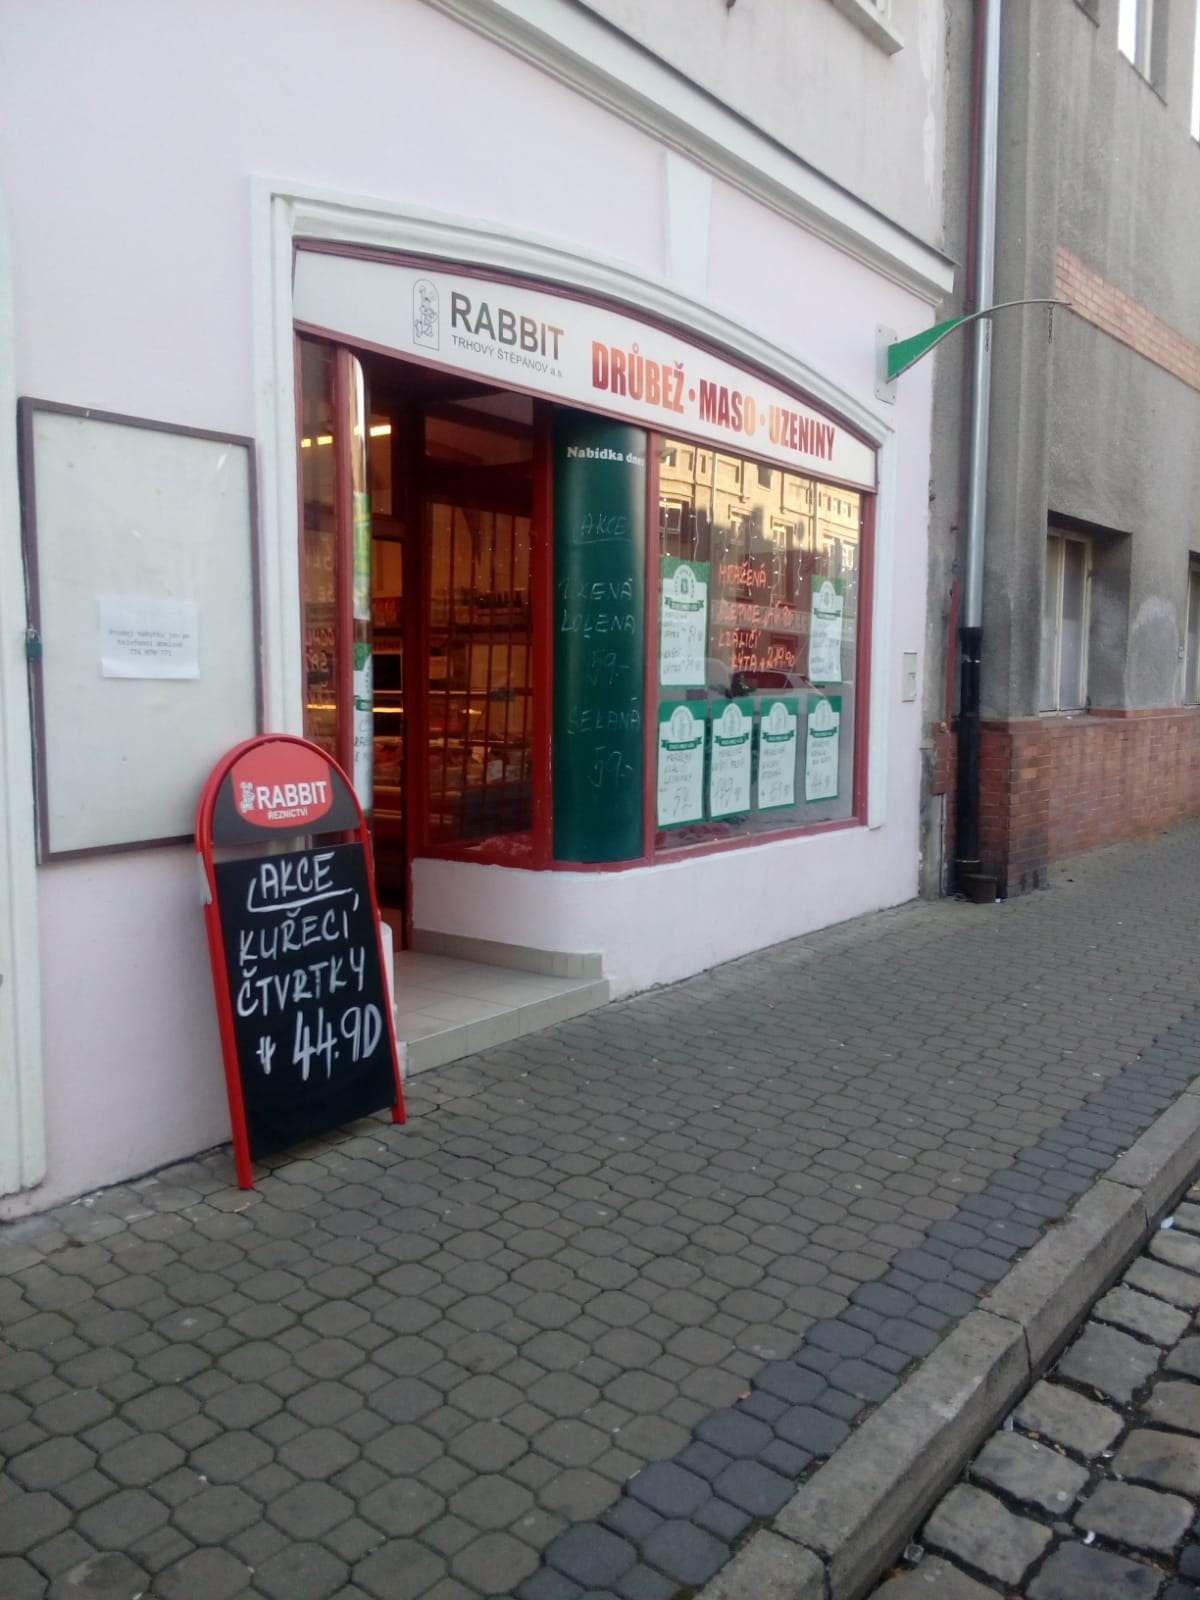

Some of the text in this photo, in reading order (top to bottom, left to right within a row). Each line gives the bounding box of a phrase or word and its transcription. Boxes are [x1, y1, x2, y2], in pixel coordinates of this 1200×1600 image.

[451, 291, 565, 361] RABBIT
[592, 341, 836, 461] DRŮBEŽ MASO UZENINY
[567, 446, 625, 462] Nabídka
[256, 780, 328, 811] RABBIT
[260, 851, 335, 900] AKCE
[237, 945, 366, 1018] ČTVRTKY
